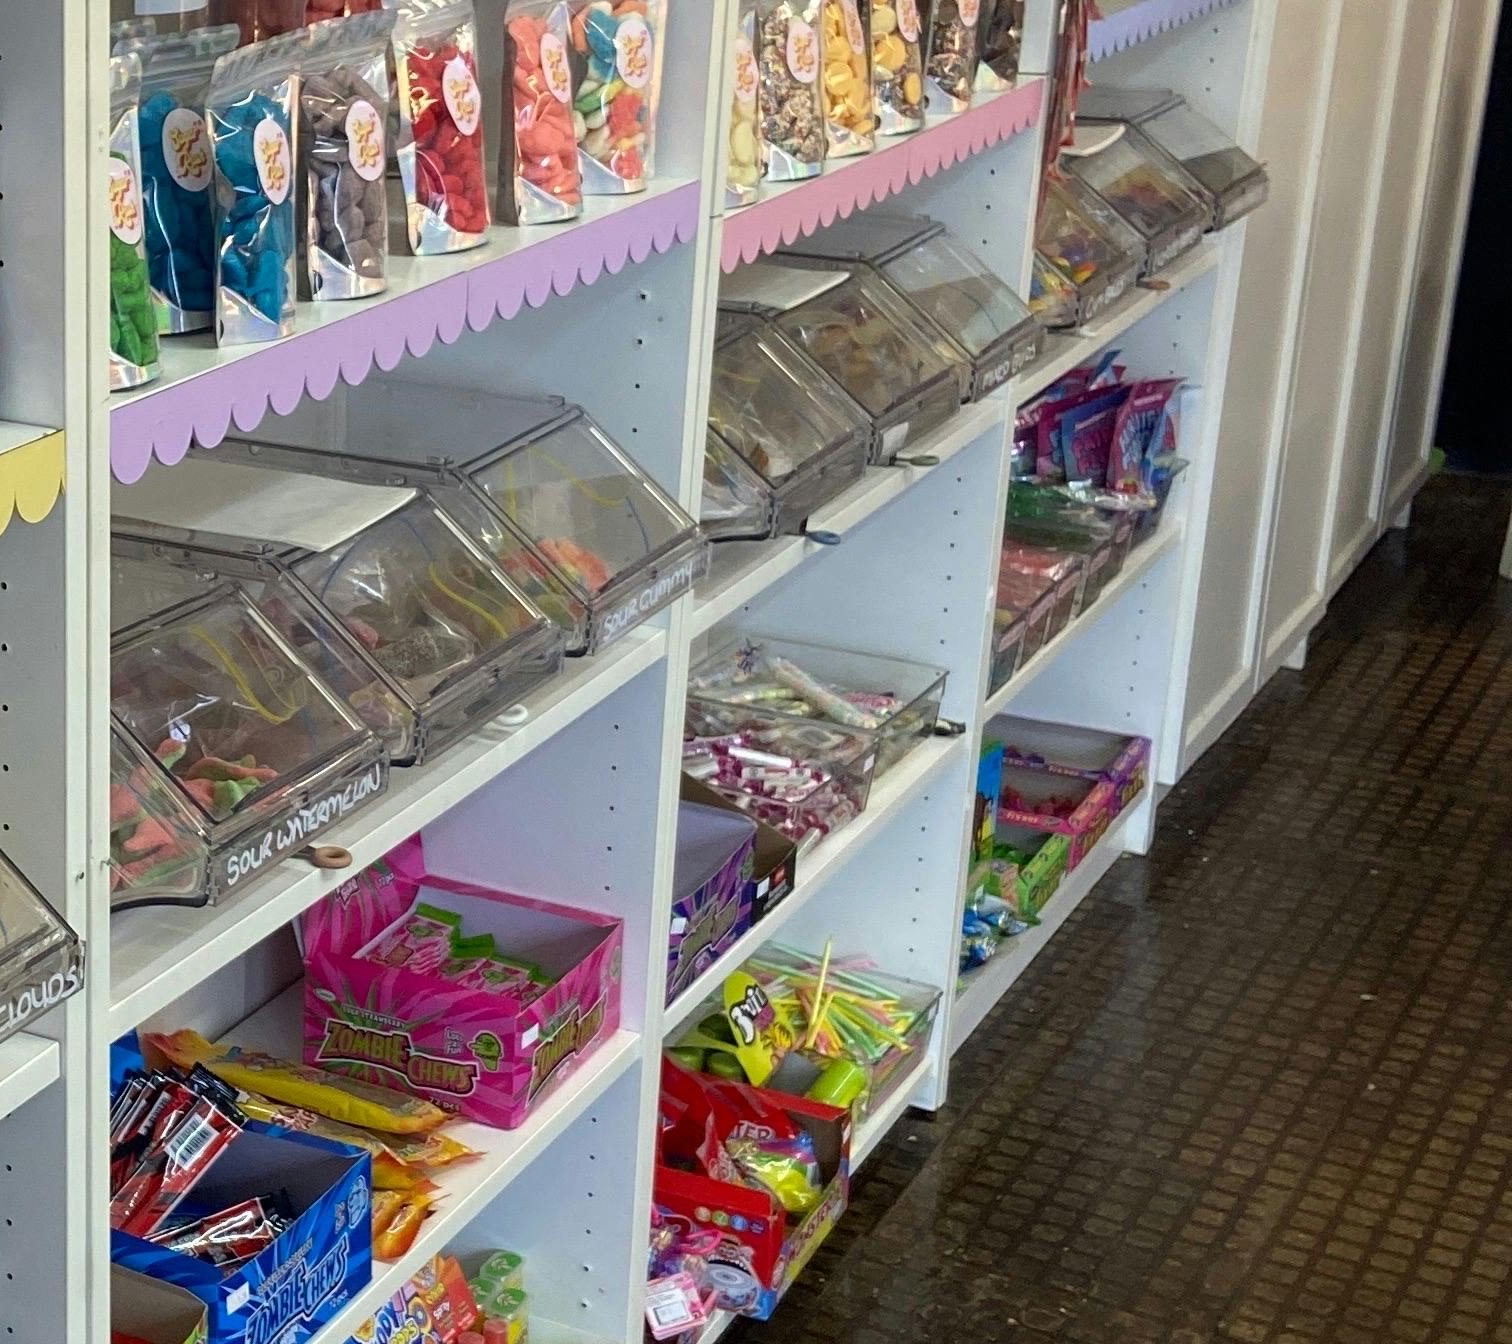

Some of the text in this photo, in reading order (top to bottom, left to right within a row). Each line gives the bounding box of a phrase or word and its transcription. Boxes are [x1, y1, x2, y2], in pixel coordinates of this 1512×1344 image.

[227, 766, 382, 887] SOUR WATERMELON
[320, 1020, 475, 1093] ZOMBIE CHEWS
[304, 1247, 345, 1313] CHEWS
